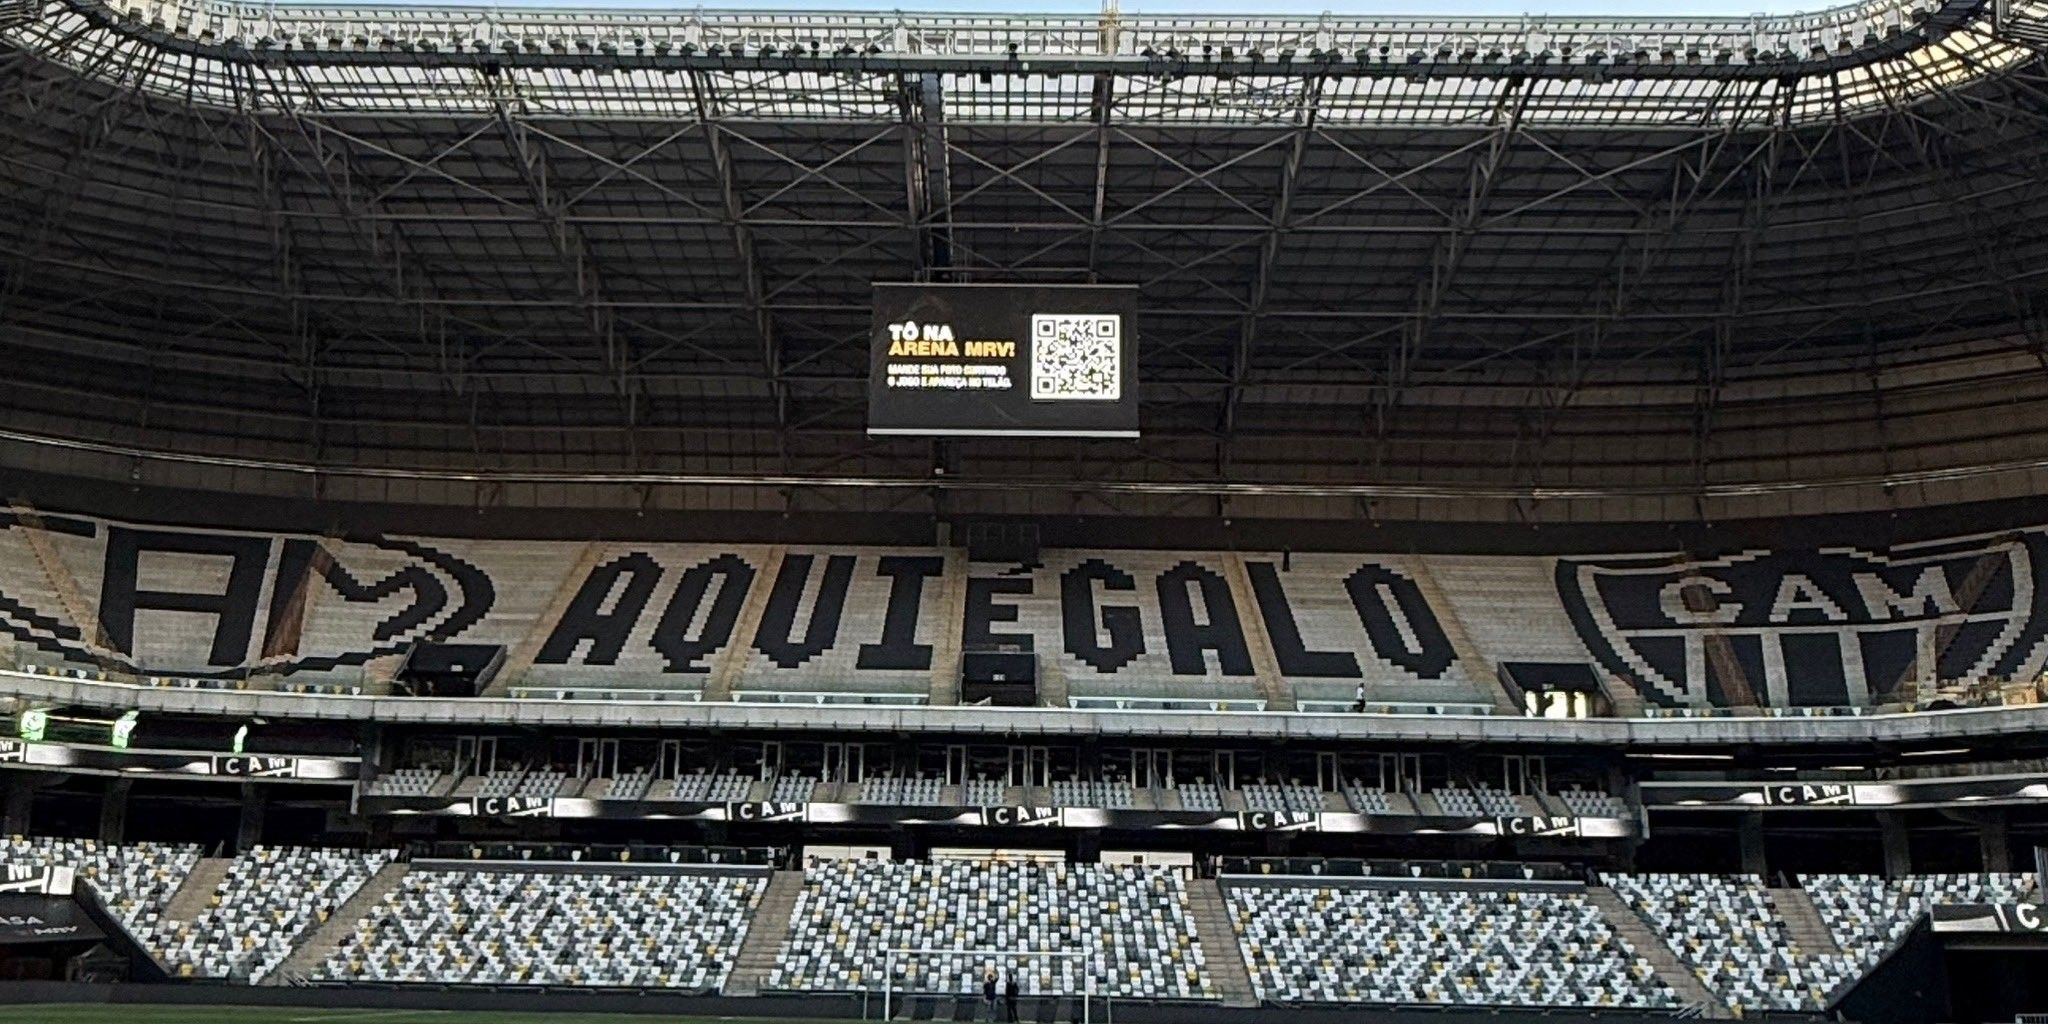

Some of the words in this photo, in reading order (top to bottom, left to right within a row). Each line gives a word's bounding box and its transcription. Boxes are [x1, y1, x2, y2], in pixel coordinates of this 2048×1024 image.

[888, 321, 919, 341] TÔ
[923, 325, 954, 341] NA
[888, 341, 959, 356] ARENA
[964, 341, 1015, 357] MRV!
[1659, 566, 1961, 624] CAM
[534, 552, 944, 673] AQUI
[1061, 558, 1459, 679] GALO
[225, 756, 286, 774] CAM
[1779, 784, 1841, 804] CAM
[485, 796, 543, 814] CAM
[740, 801, 797, 819] CAM
[994, 806, 1052, 824] CAM
[1252, 811, 1309, 830] CAM
[1510, 816, 1569, 833] CAM
